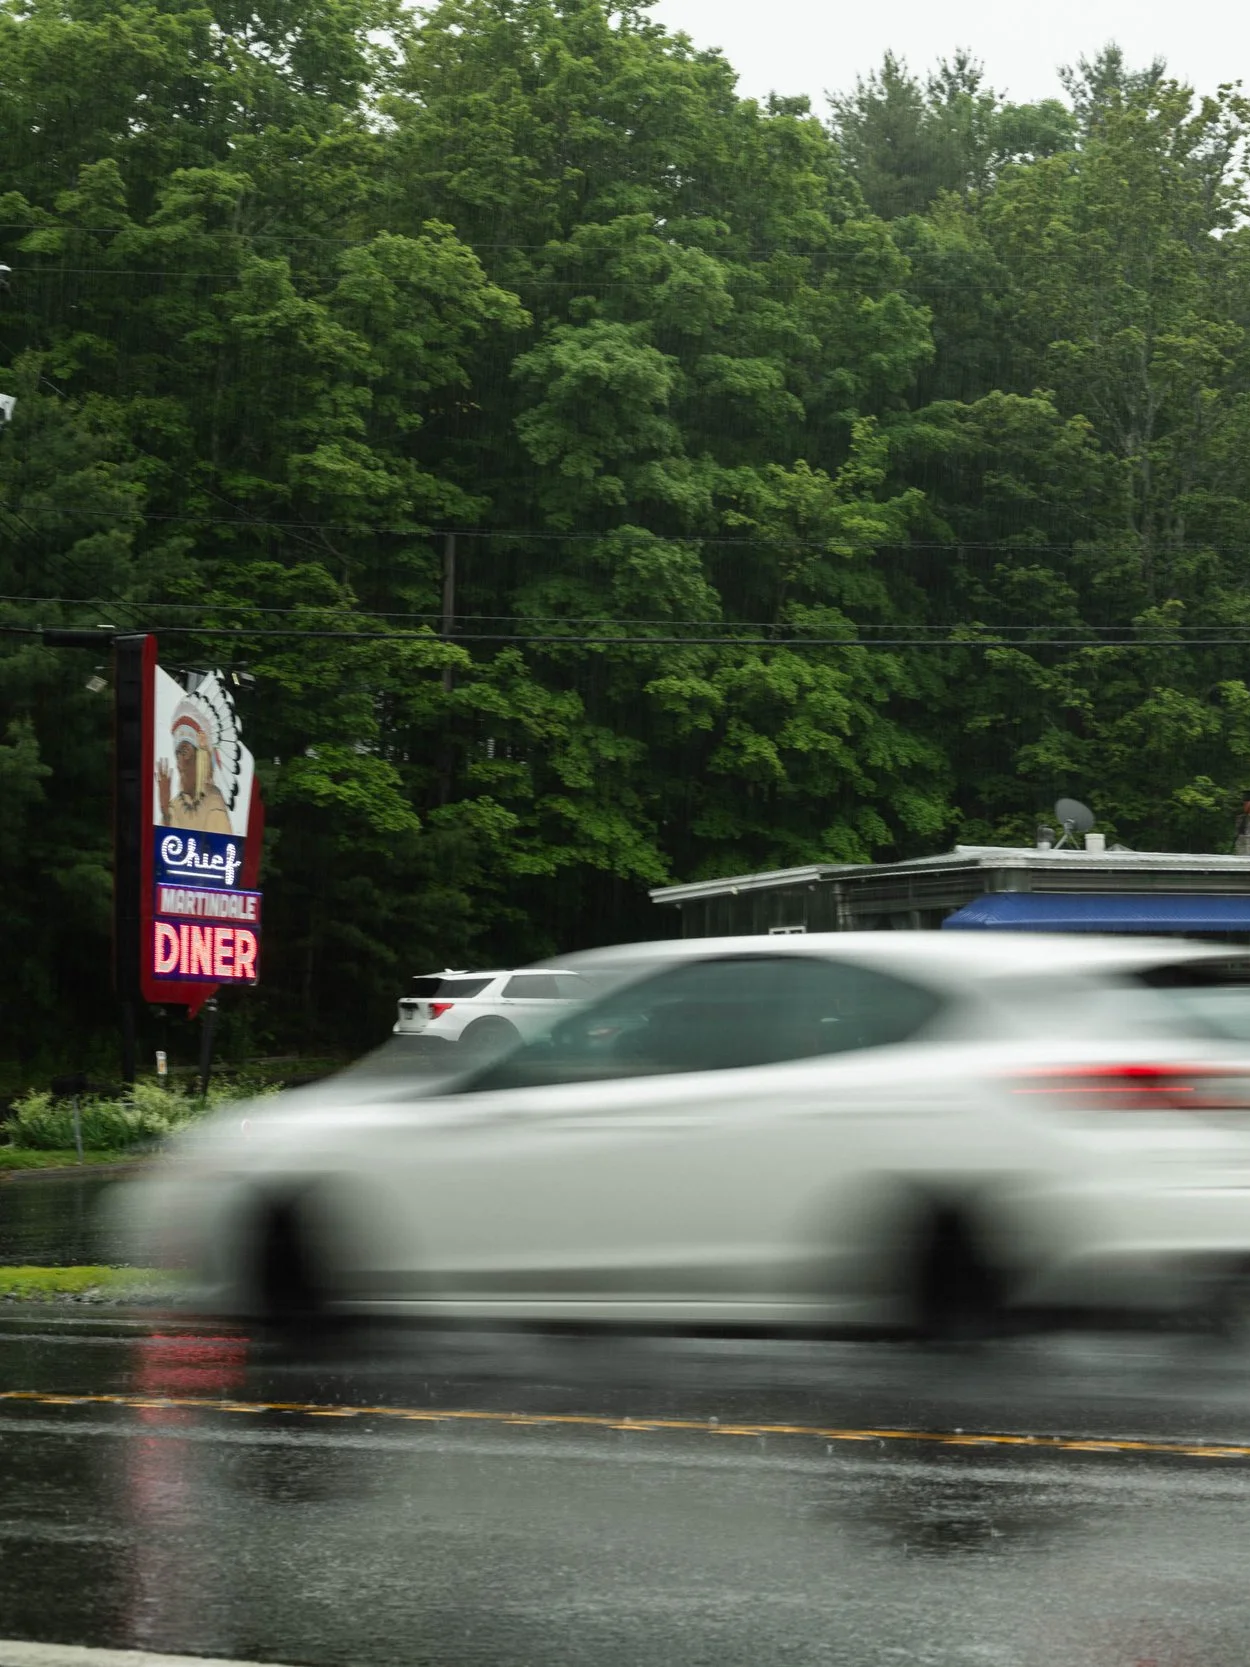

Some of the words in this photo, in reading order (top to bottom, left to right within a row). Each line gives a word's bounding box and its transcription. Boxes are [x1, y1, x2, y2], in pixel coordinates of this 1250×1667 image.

[161, 835, 242, 885] Chief
[160, 887, 256, 920] MARTINDALE
[154, 921, 258, 978] DINER
